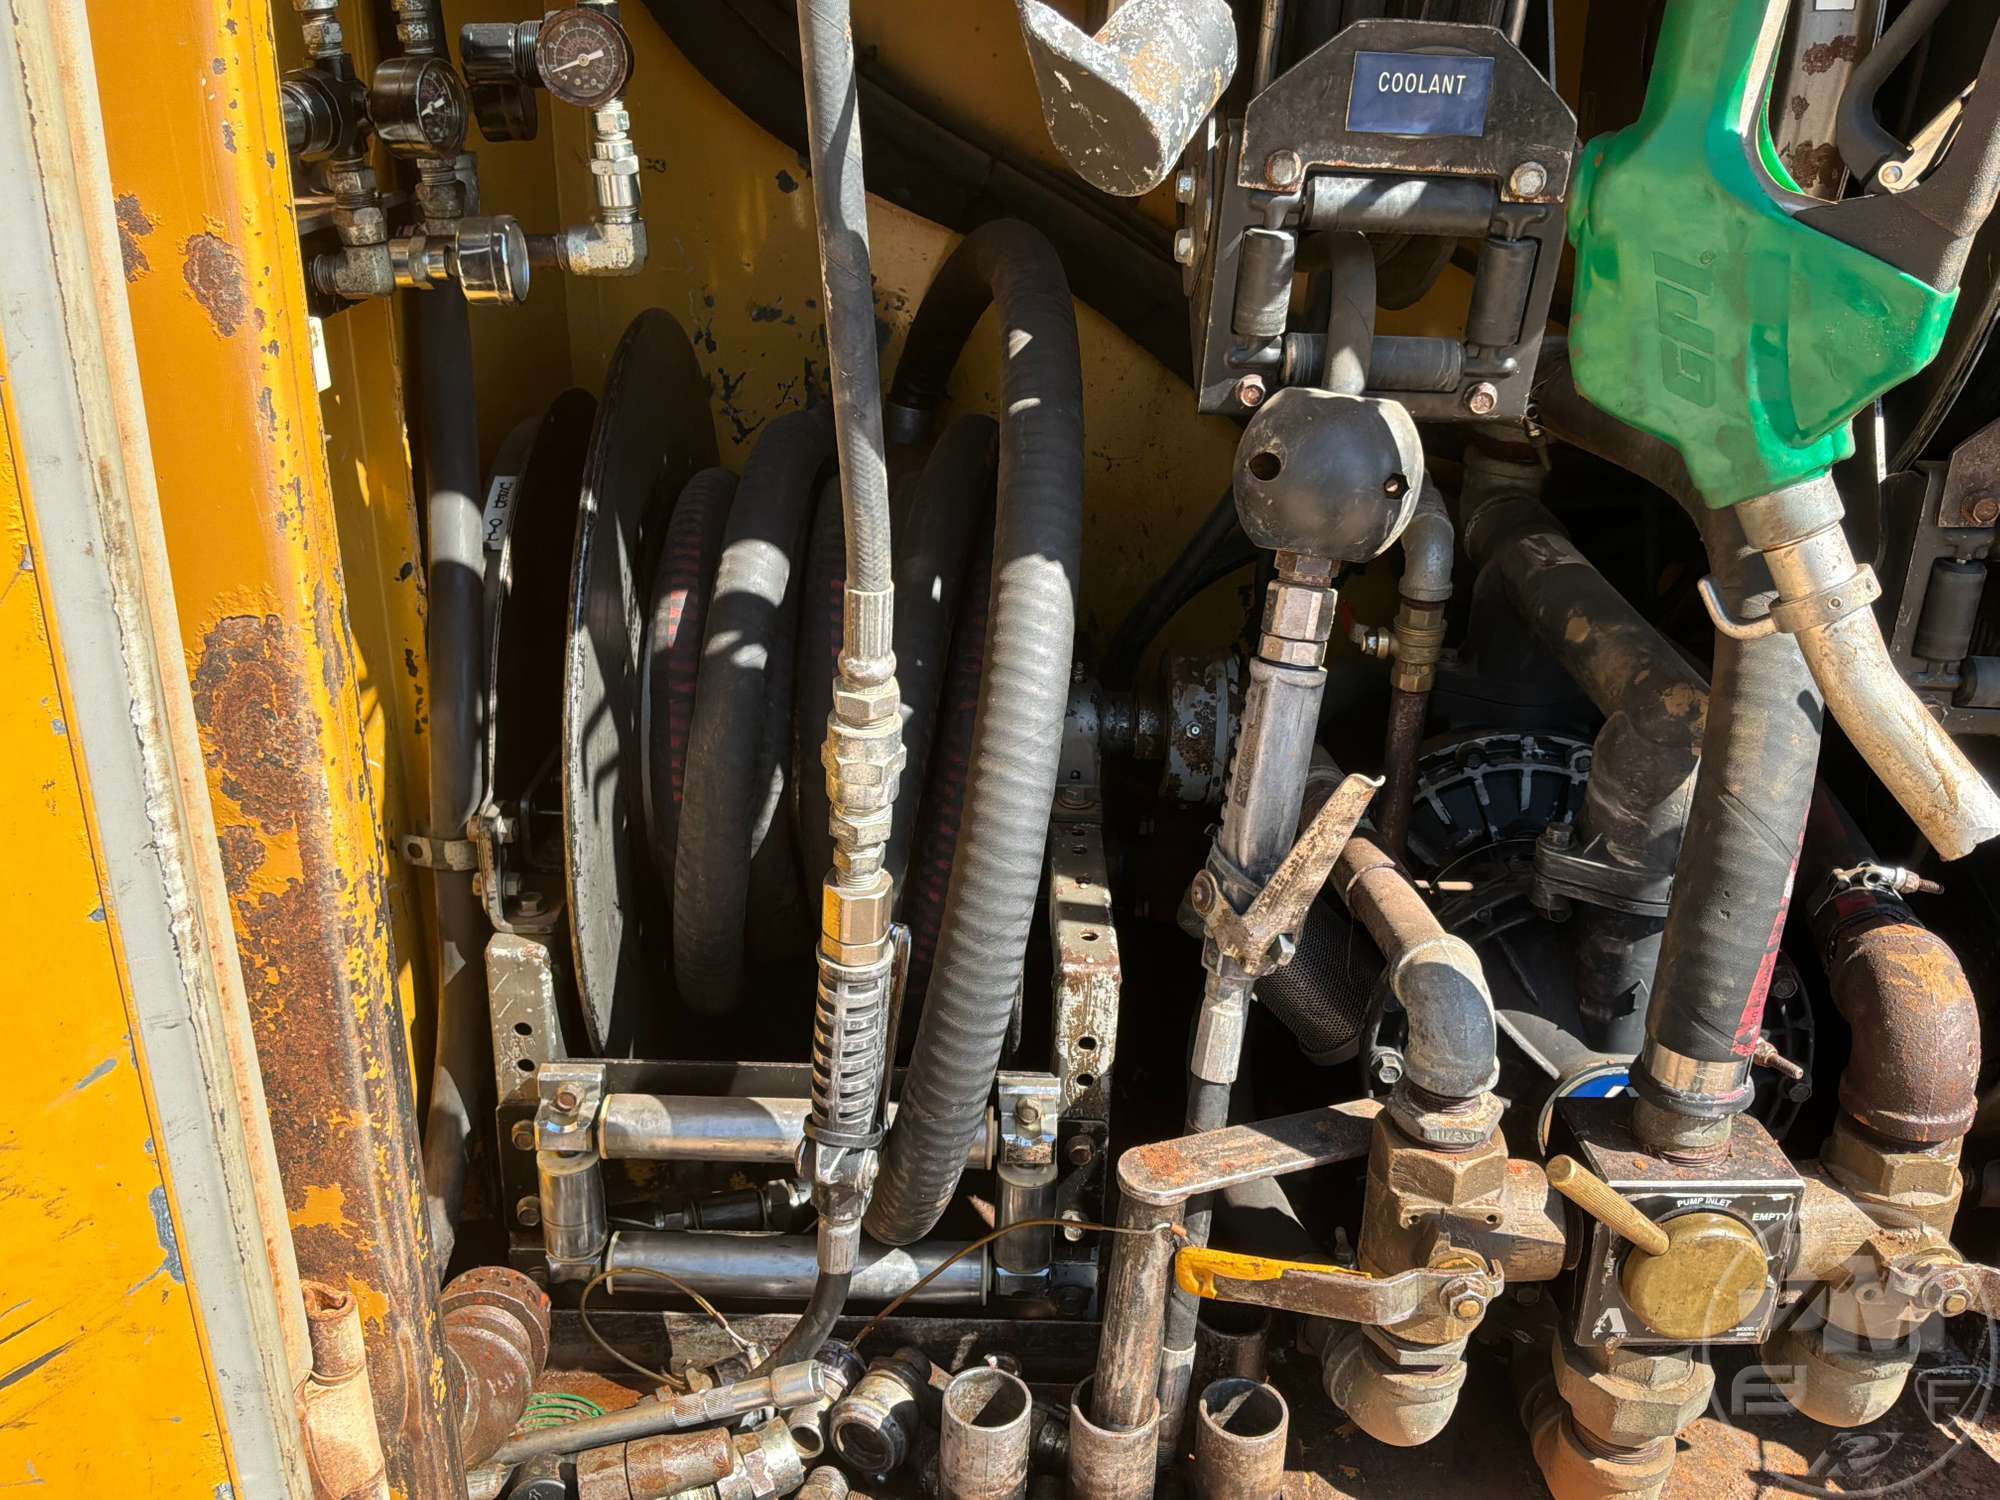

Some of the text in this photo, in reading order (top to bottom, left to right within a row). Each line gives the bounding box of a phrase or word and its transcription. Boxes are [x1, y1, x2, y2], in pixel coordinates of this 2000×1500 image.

[1378, 71, 1467, 95] COOLANT
[1677, 1196, 1733, 1208] PUMP INLET
[1752, 1211, 1787, 1222] EMPTY
